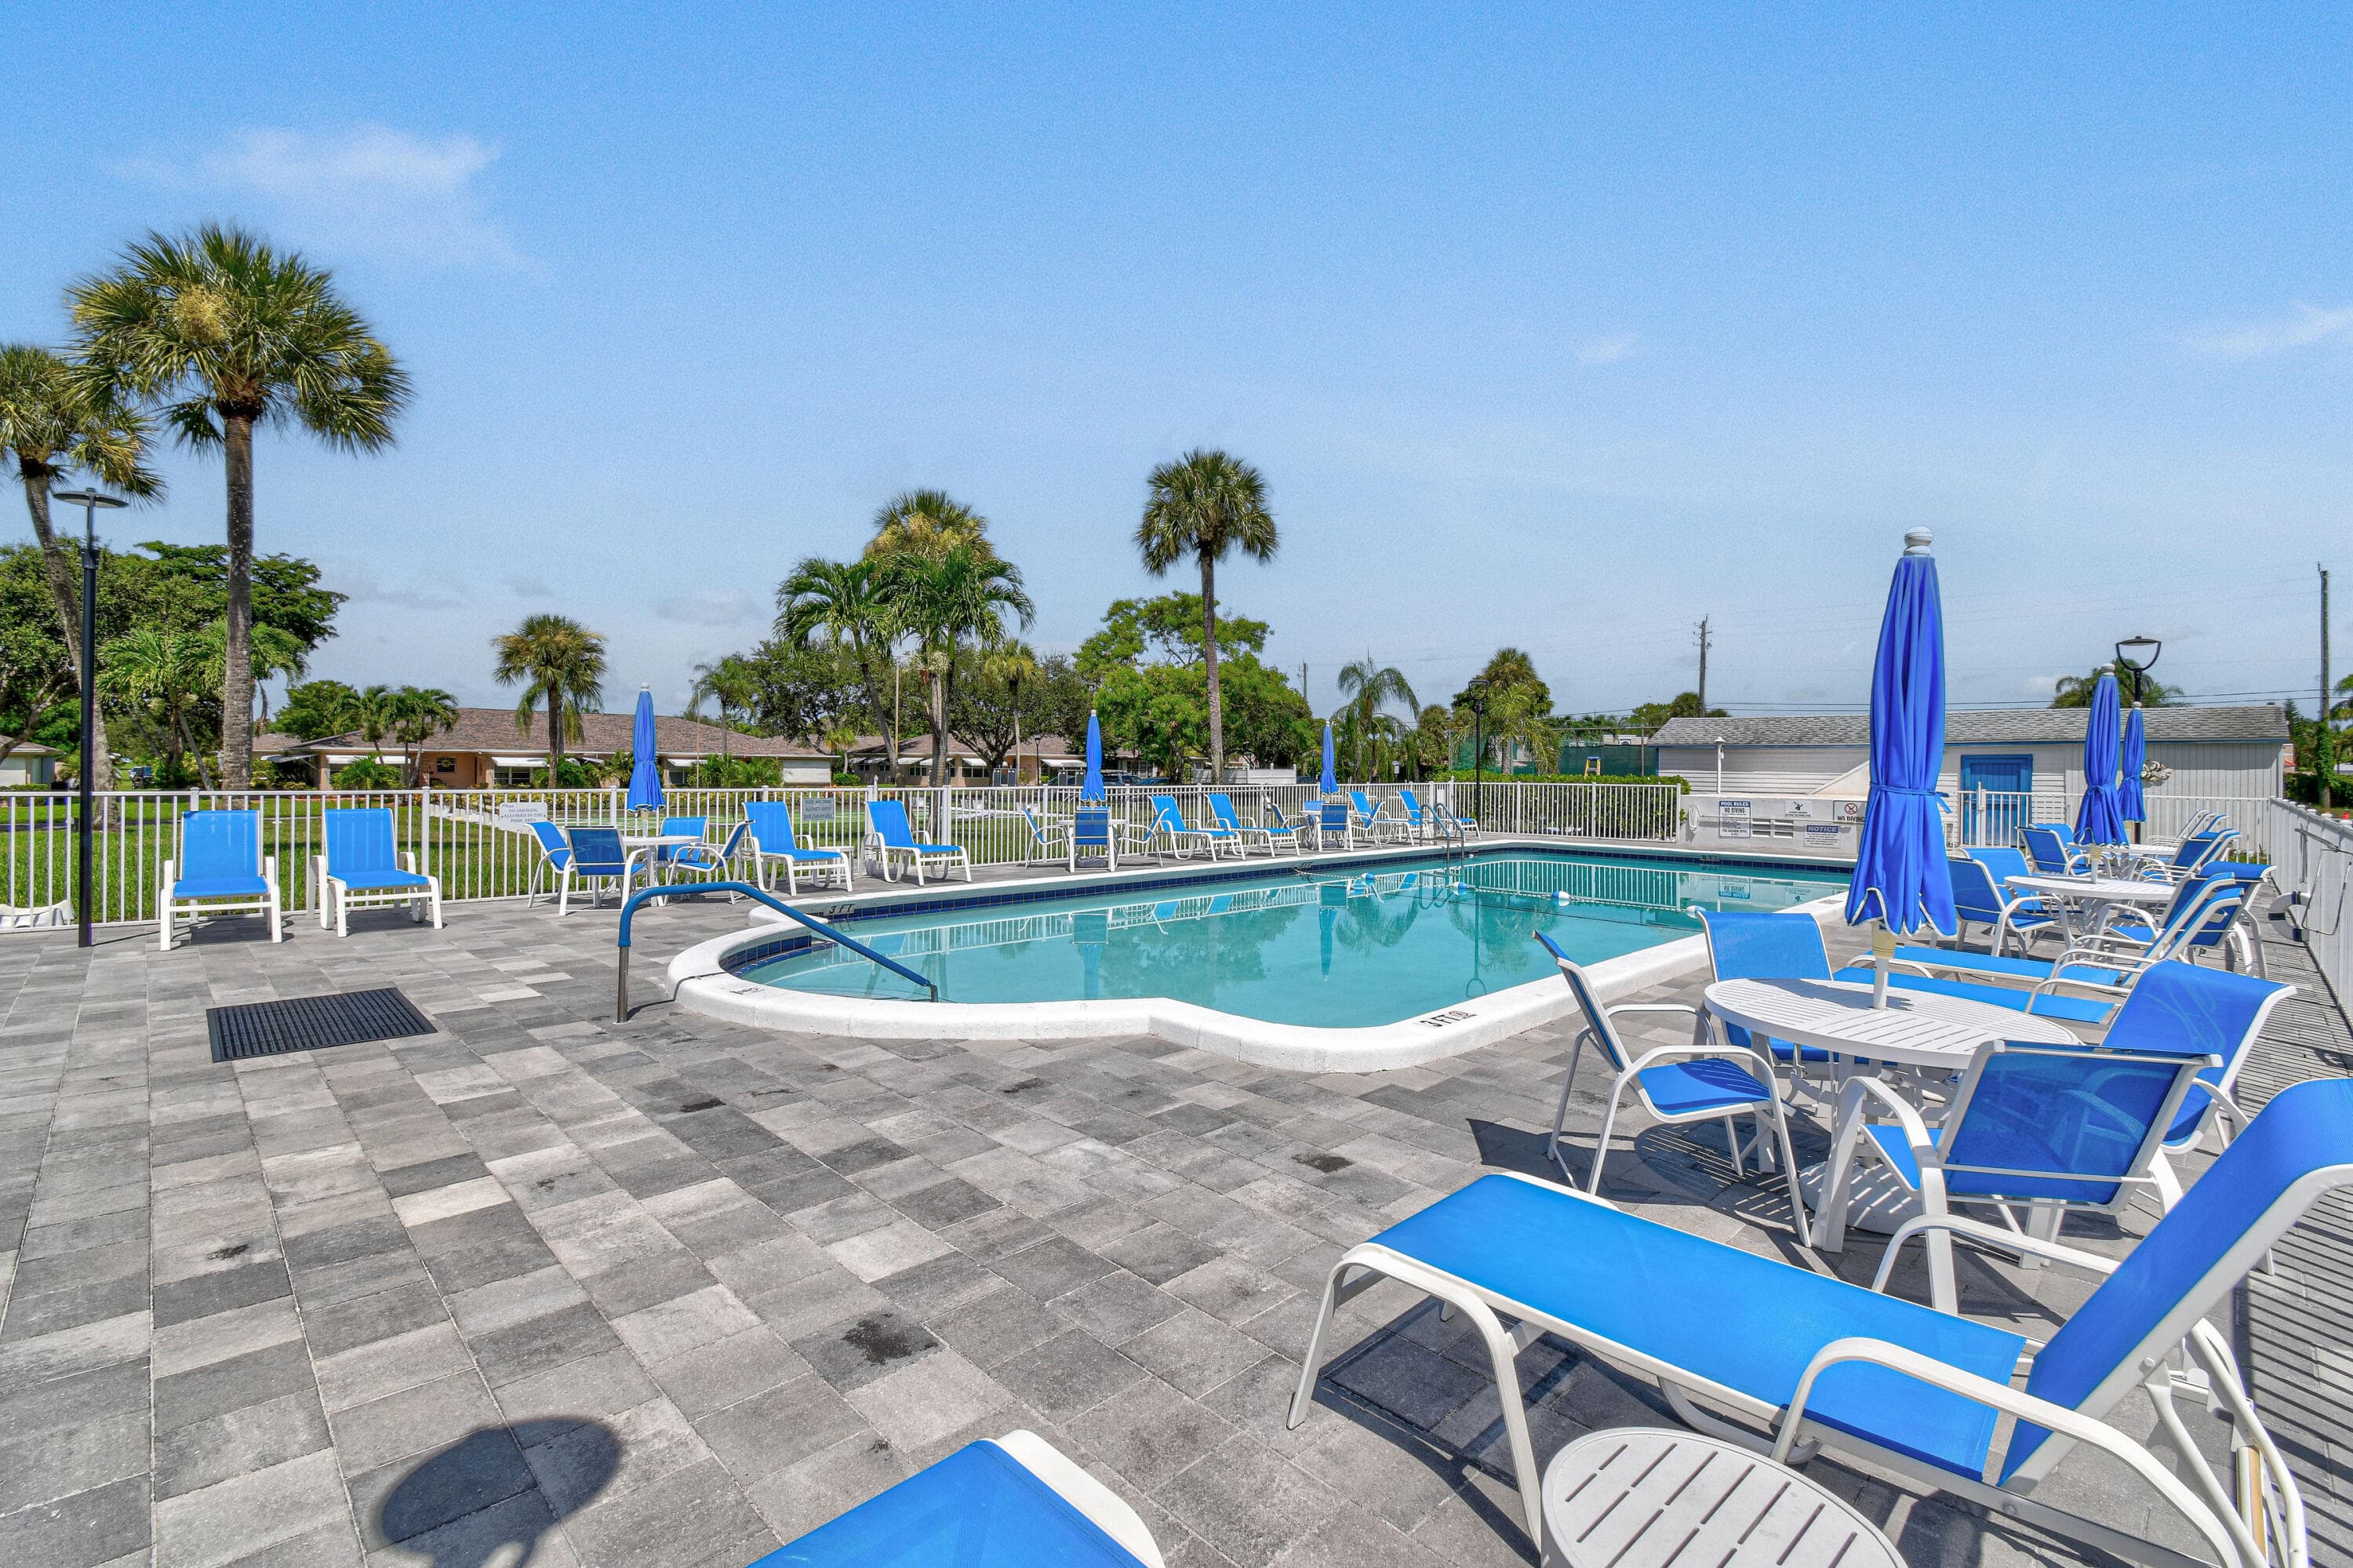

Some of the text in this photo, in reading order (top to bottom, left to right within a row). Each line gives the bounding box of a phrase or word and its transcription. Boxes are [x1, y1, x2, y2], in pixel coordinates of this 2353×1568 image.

[829, 903, 855, 914] 3 FT
[1430, 1014, 1460, 1024] FT
